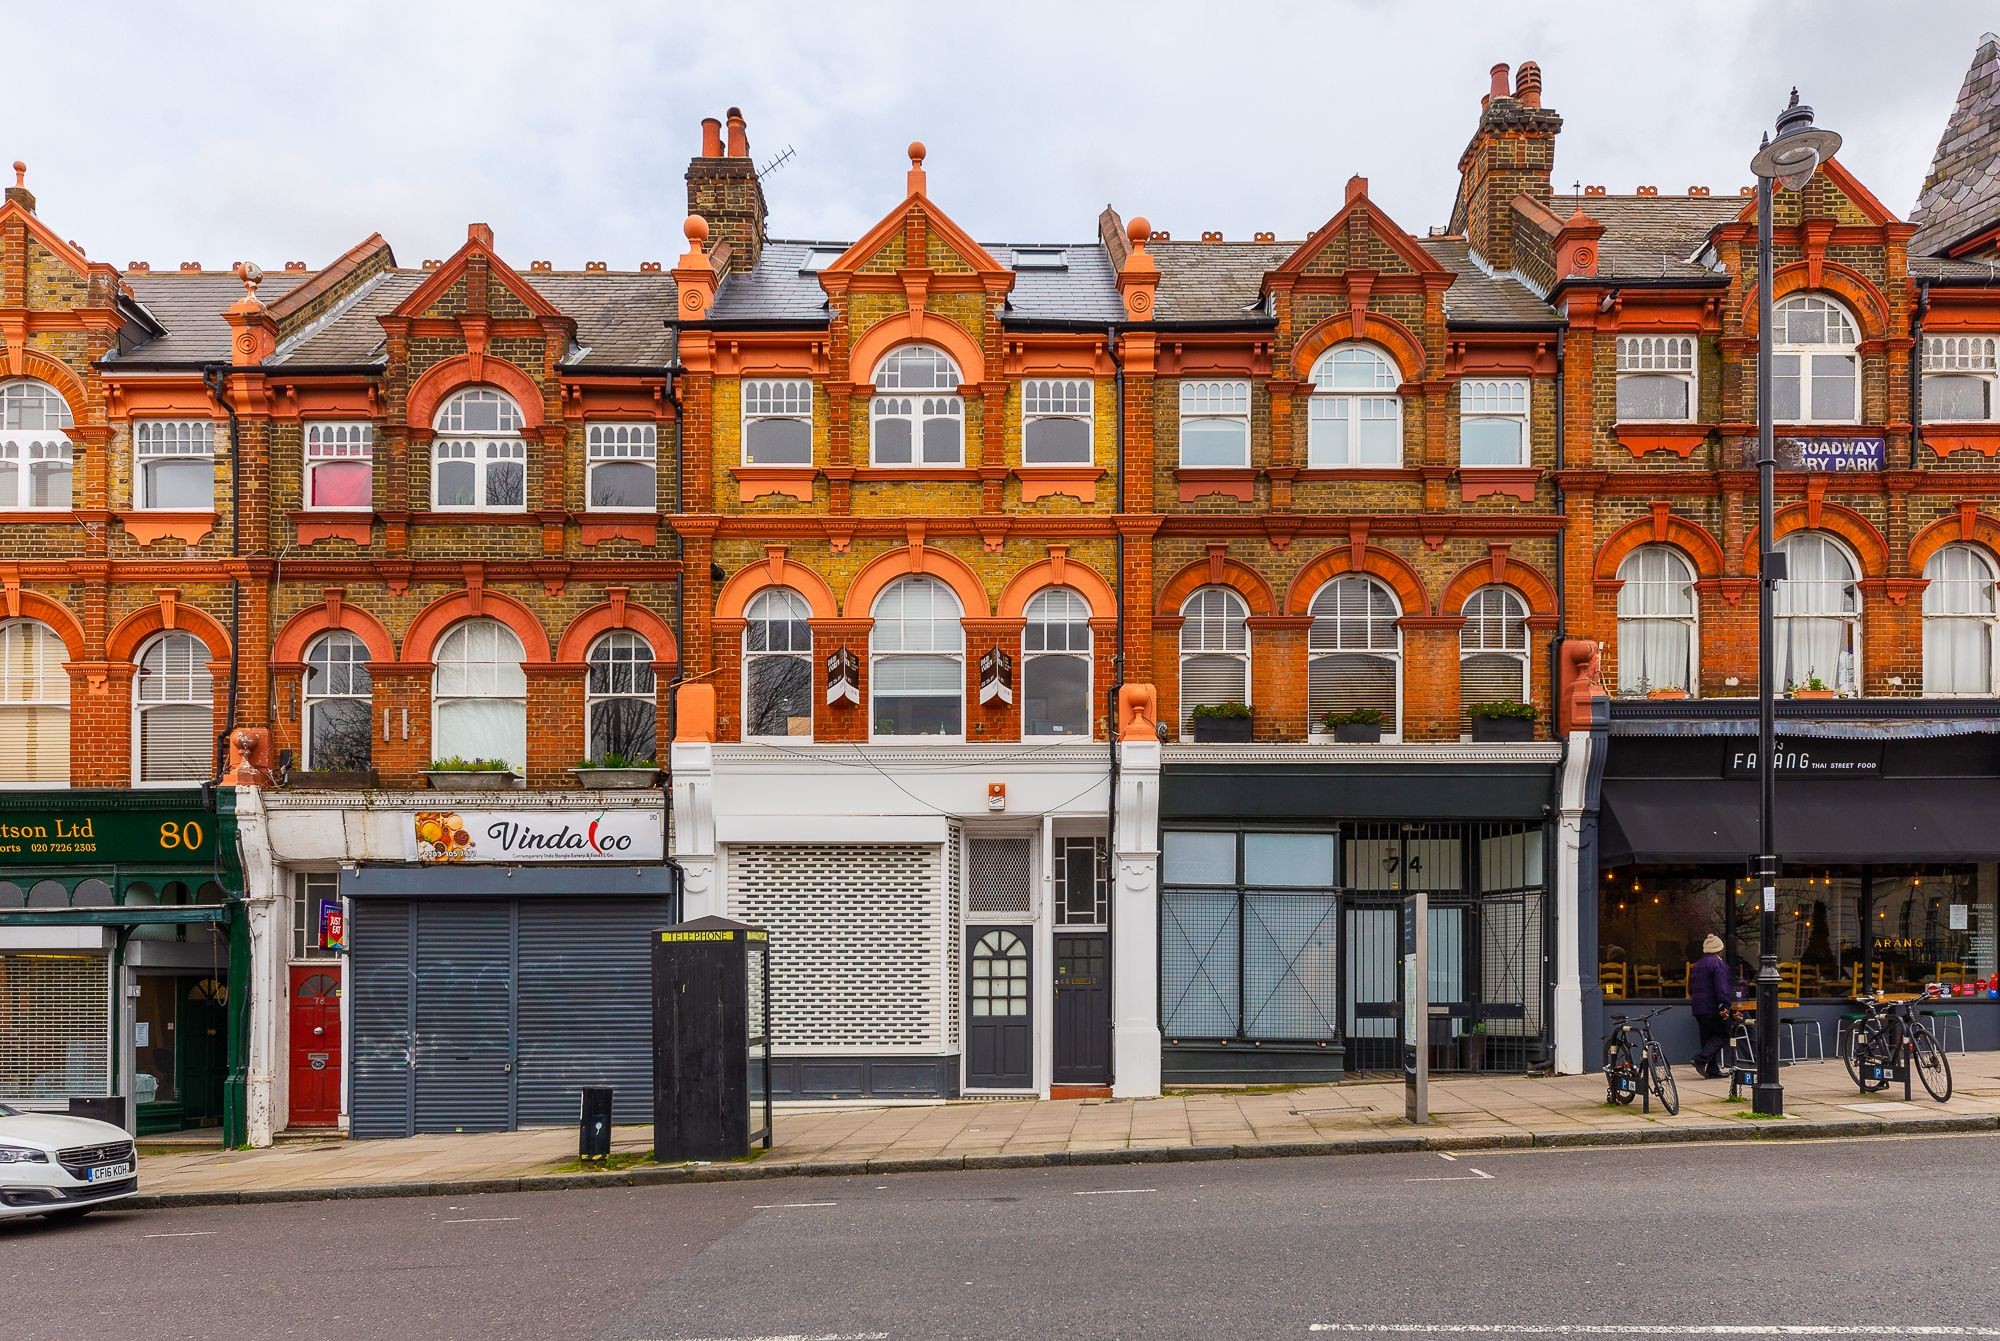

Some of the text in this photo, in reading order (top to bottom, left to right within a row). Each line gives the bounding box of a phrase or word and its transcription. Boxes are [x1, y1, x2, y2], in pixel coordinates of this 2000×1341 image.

[1835, 457, 1879, 471] PARK
[1734, 752, 1809, 769] FAANG
[0, 818, 94, 838] tson Ltd
[159, 821, 204, 850] 80
[31, 843, 48, 853] 020
[50, 843, 72, 853] 7226
[74, 843, 96, 853] 2303
[1389, 855, 1423, 874] 74
[330, 916, 342, 926] JUST
[332, 926, 342, 935] EAT
[669, 931, 728, 941] TELEPHONE
[314, 997, 325, 1005] 78
[95, 1164, 127, 1179] CF16 KOH
